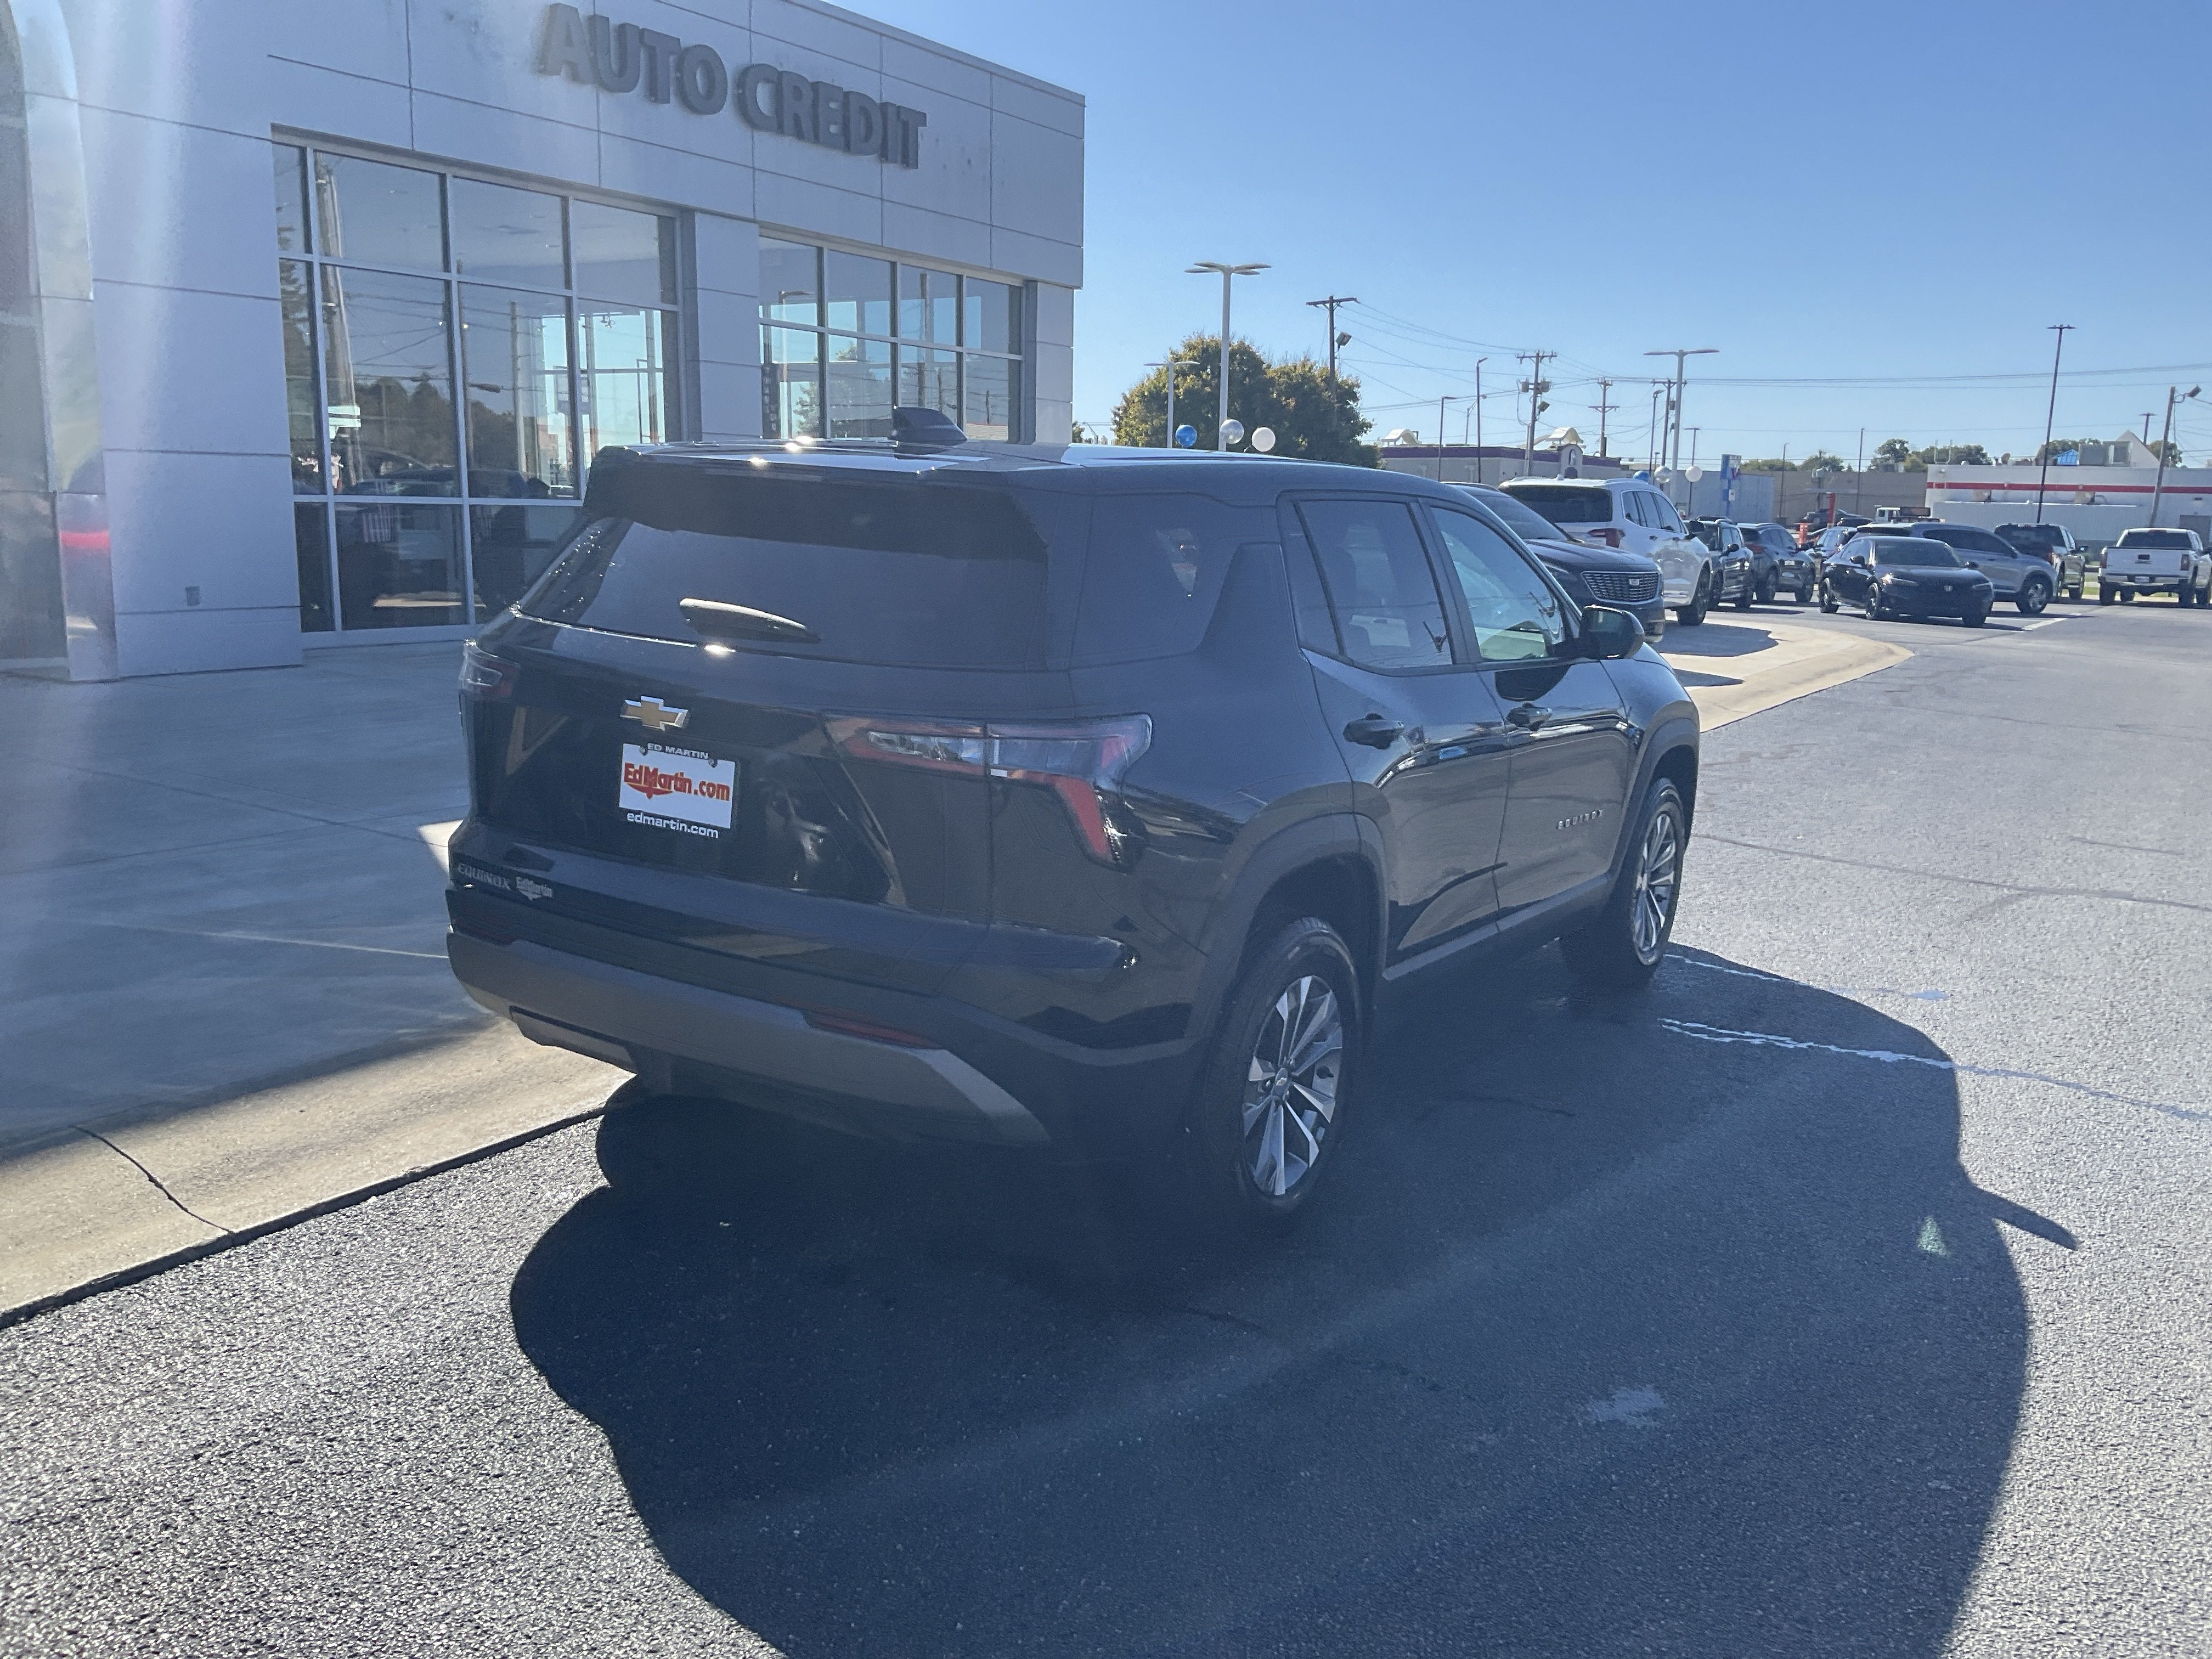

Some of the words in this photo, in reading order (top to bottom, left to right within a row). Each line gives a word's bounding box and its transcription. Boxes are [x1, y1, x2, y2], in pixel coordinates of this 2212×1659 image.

[534, 3, 728, 115] AUTO
[736, 63, 927, 170] CREDIT
[647, 743, 662, 751] ED
[665, 746, 708, 759] MARTIN
[623, 762, 730, 802] EdMartin.com
[627, 811, 719, 838] edmartin.com
[1558, 809, 1603, 830] EQUINOX
